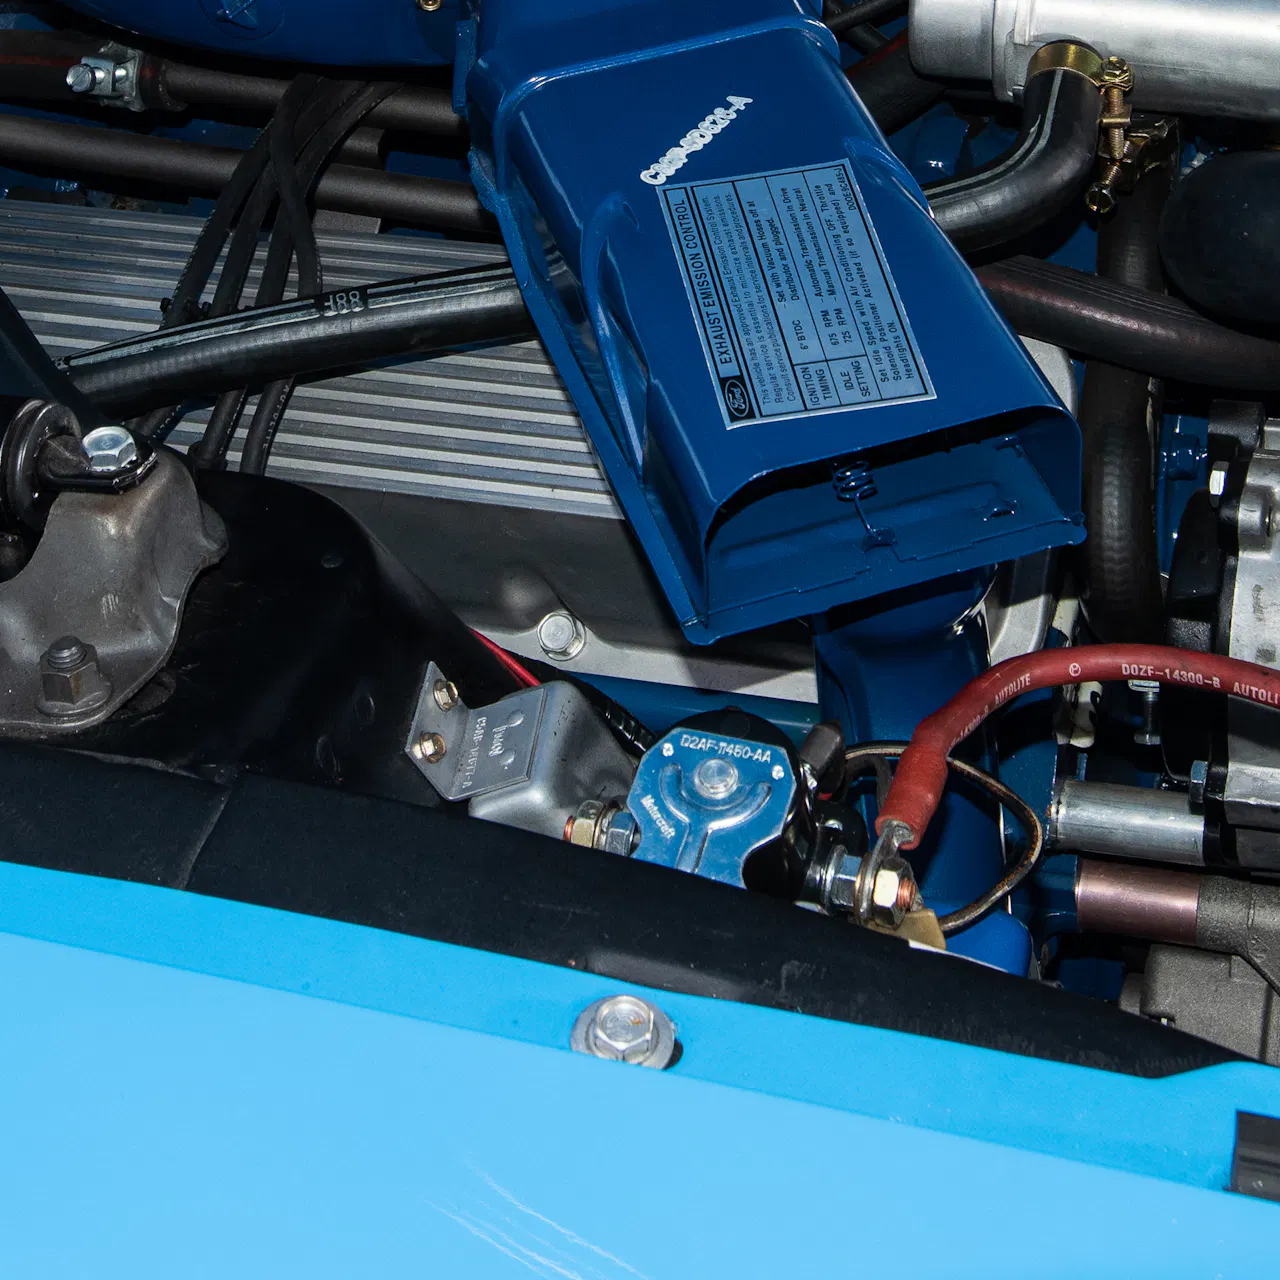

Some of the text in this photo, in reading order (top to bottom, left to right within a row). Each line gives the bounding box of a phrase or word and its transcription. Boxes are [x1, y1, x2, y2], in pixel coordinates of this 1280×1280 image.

[778, 186, 791, 203] Drive
[791, 187, 808, 212] Neutral
[812, 184, 830, 212] Throttle
[823, 182, 836, 196] and
[829, 198, 852, 234] equipped)
[707, 221, 722, 245] Control
[721, 228, 738, 255] exhaust
[734, 228, 745, 241] and
[752, 219, 767, 240] Hoses
[786, 212, 810, 258] Transmission
[843, 237, 854, 247] so
[759, 241, 776, 270] Vacuum
[774, 247, 787, 261] and
[803, 220, 827, 267] Transmission
[714, 244, 732, 275] Emission
[829, 233, 857, 282] Conditioning
[672, 199, 733, 364] EXHAUST EMISSION CONTROL
[730, 256, 748, 289] minimize
[769, 271, 782, 288] with
[779, 262, 800, 300] Distributor
[852, 261, 873, 299] Activated
[723, 275, 740, 303] Exhaust
[741, 290, 752, 299] to
[755, 294, 766, 304] for
[847, 284, 860, 297] Air
[732, 302, 752, 337] approved
[744, 300, 763, 334] essential
[819, 309, 834, 327] RPM
[832, 307, 847, 326] RPM
[852, 299, 867, 317] with
[859, 320, 879, 346] Speed
[866, 302, 889, 342] Positioner
[742, 337, 754, 347] an
[755, 334, 765, 342] is
[827, 332, 840, 346] 675
[840, 329, 854, 344] 725
[746, 347, 758, 361] has
[758, 344, 774, 371] service
[771, 347, 788, 373] service
[869, 348, 884, 365] Idle
[881, 345, 903, 380] Solenoid
[891, 334, 917, 379] Headlights
[750, 362, 767, 387] vehicle
[767, 372, 786, 403] Regular
[799, 365, 821, 406] IGNITION
[813, 368, 833, 400] TIMING
[839, 370, 855, 391] IDLE
[849, 359, 871, 397] SETTING
[876, 368, 890, 382] Set
[725, 386, 746, 411] Ford
[758, 388, 772, 405] This
[994, 673, 1031, 705] AUTOLITE
[679, 733, 772, 765] D2AF-11450-AA
[640, 794, 676, 839] Motorcraft
